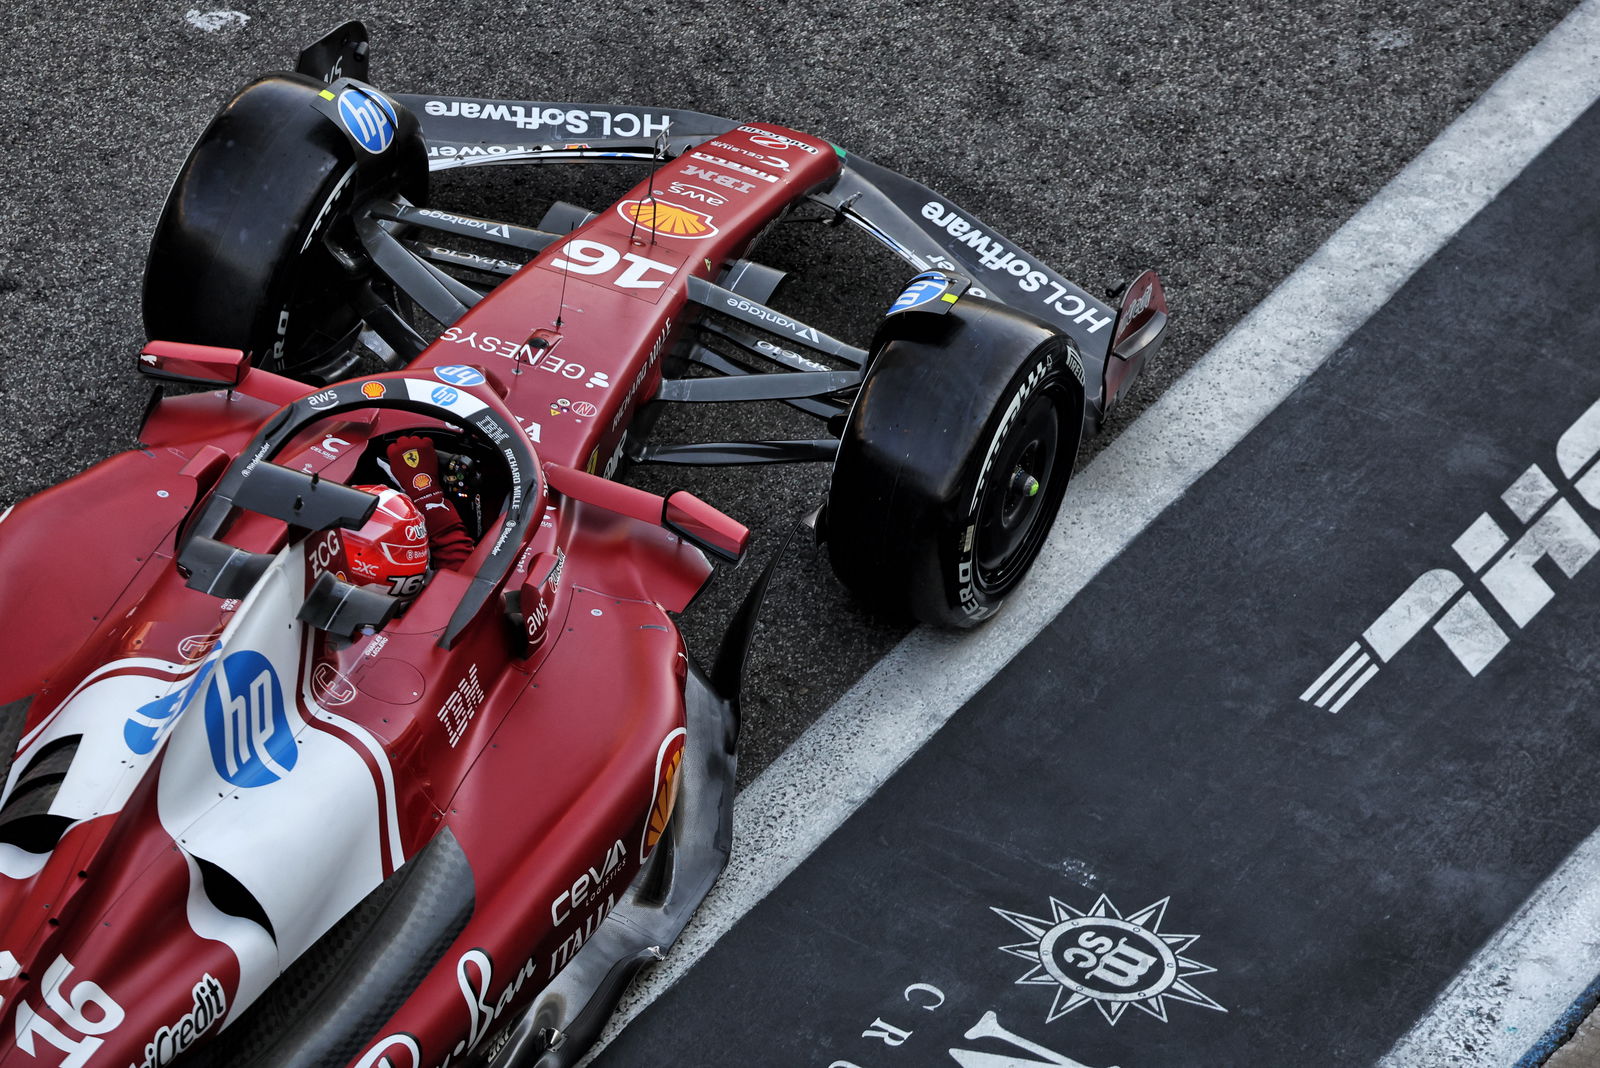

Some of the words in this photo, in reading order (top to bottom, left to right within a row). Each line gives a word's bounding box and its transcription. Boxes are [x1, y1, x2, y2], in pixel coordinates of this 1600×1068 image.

[424, 101, 670, 137] HCLSoftware
[667, 184, 725, 207] aws
[680, 164, 756, 194] IBM
[419, 209, 487, 230] vantage
[550, 239, 677, 289] 16
[921, 201, 1112, 334] HCLSoftware
[726, 298, 796, 331] vantage
[440, 327, 586, 380] GENESYS
[437, 365, 482, 386] hp
[308, 390, 338, 406] aws
[432, 386, 458, 406] hp
[476, 415, 510, 445] IBM
[504, 448, 521, 484] RICHARD
[512, 485, 521, 510] MILLE
[388, 575, 424, 597] 16
[527, 598, 549, 636] aws
[210, 655, 293, 781] hp
[437, 663, 484, 748] IBM
[585, 857, 627, 906] LOGISTICS
[548, 892, 615, 980] ITALIA
[15, 953, 125, 1068] 16
